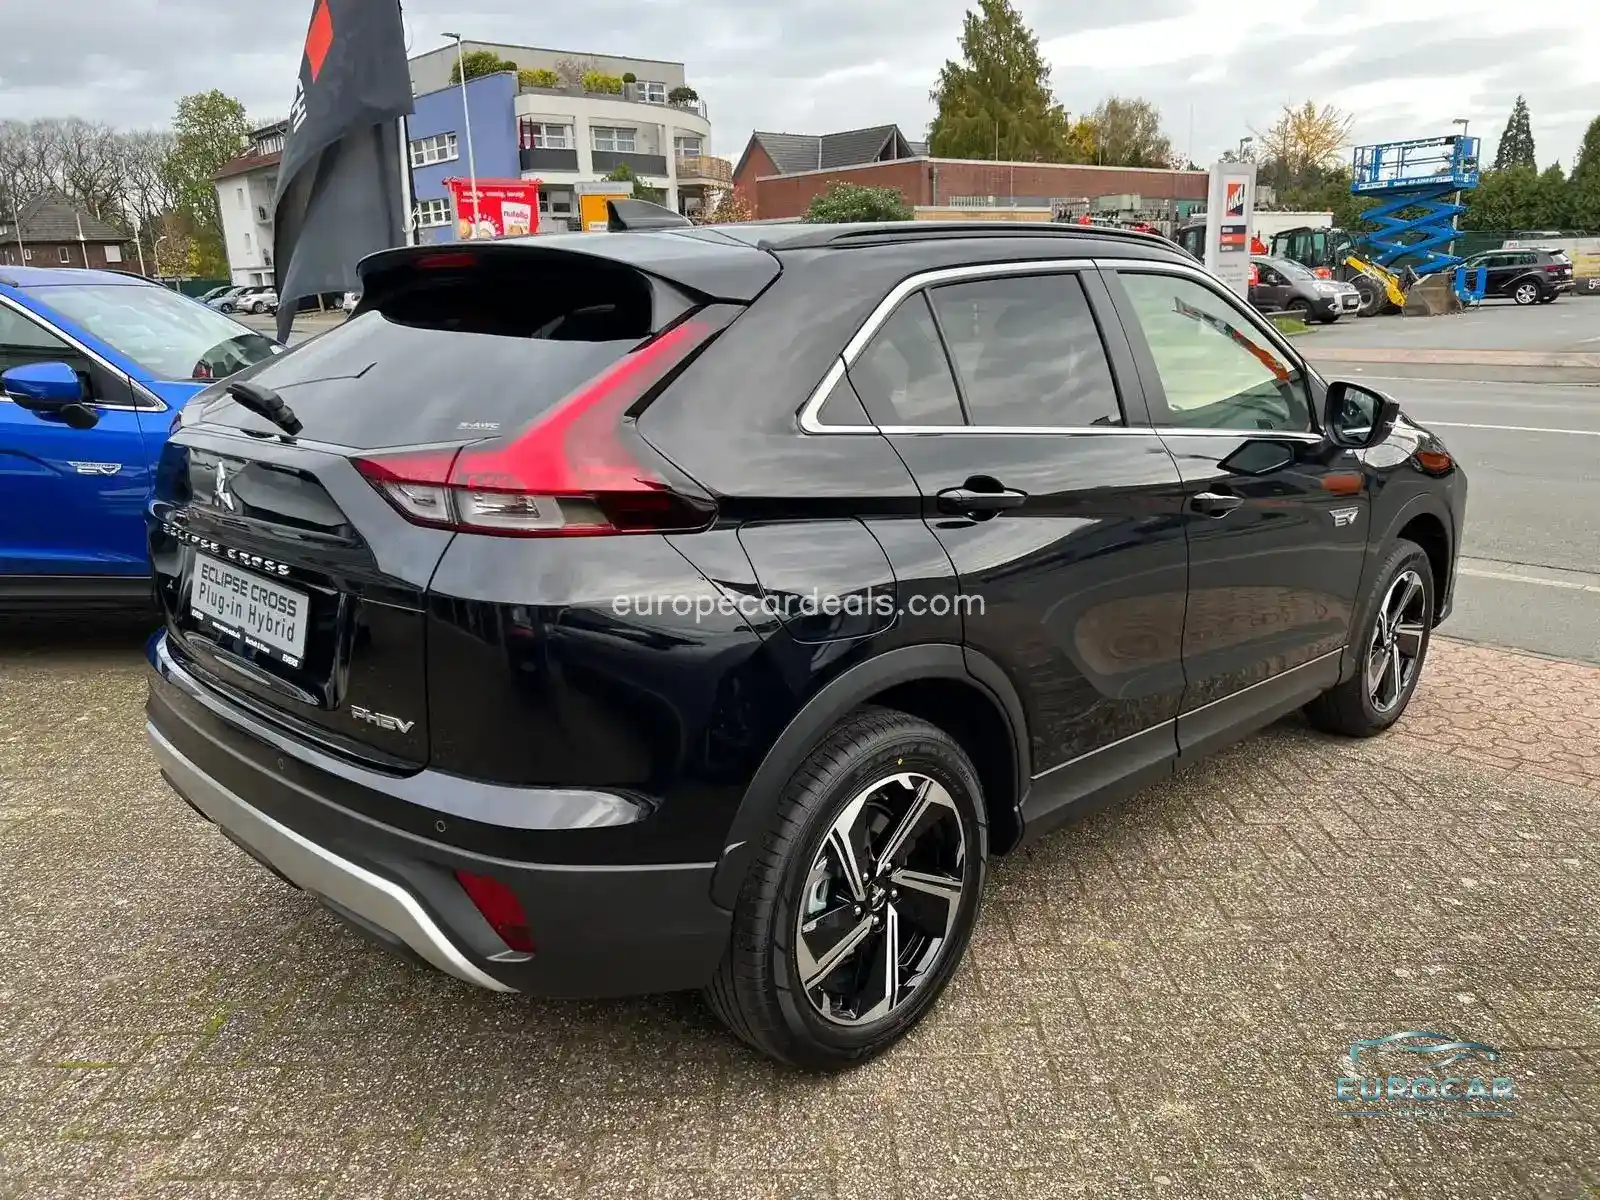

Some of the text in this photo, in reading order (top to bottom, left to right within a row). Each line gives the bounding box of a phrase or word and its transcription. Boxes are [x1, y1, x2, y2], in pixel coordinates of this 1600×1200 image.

[503, 210, 529, 219] nutella
[162, 522, 290, 575] ECLIPSE CROSS
[199, 581, 242, 618] Plug-in
[248, 602, 296, 643] Hybrid
[201, 563, 297, 618] ECLIPSE CROSS
[351, 704, 415, 733] PHEV
